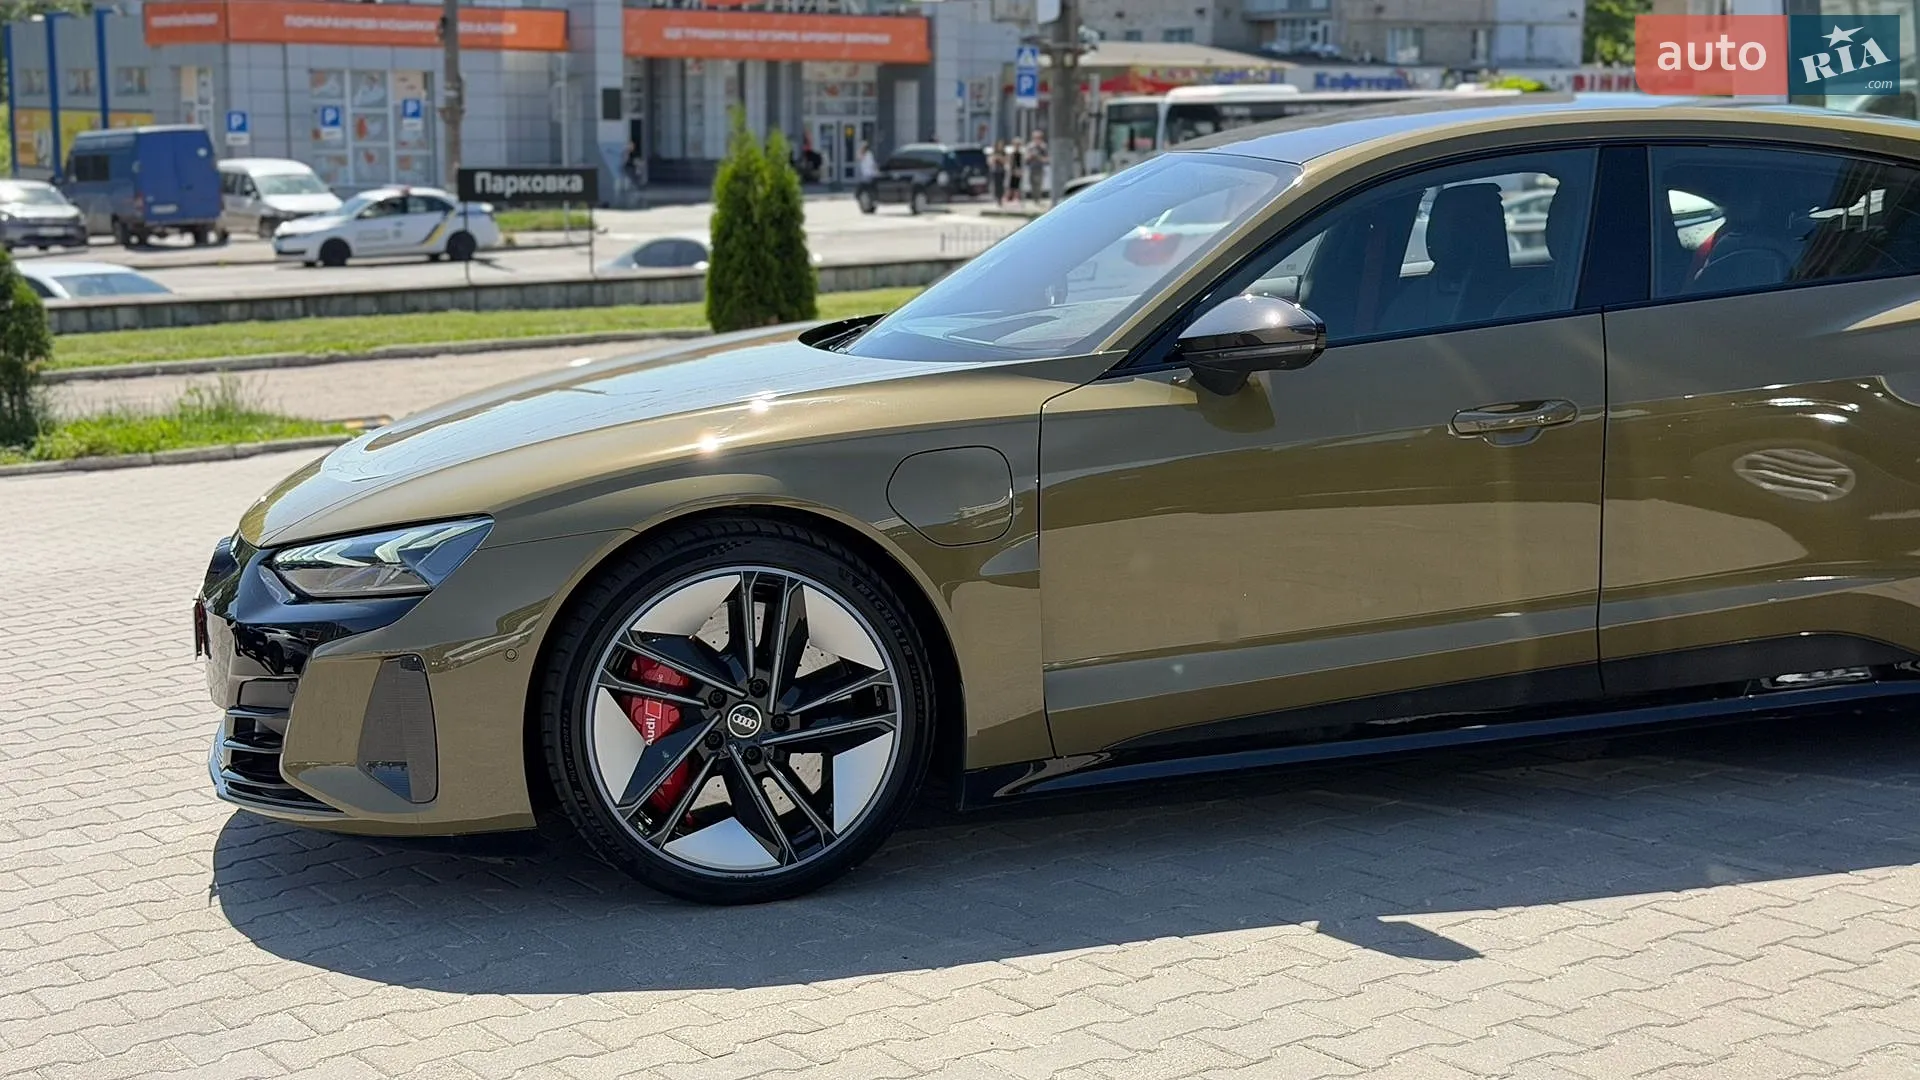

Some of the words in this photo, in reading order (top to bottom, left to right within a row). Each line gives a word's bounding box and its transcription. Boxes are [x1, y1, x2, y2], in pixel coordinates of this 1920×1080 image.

[474, 171, 584, 199] Парковка
[857, 581, 913, 658] MICHELIN
[645, 718, 656, 746] Audi
